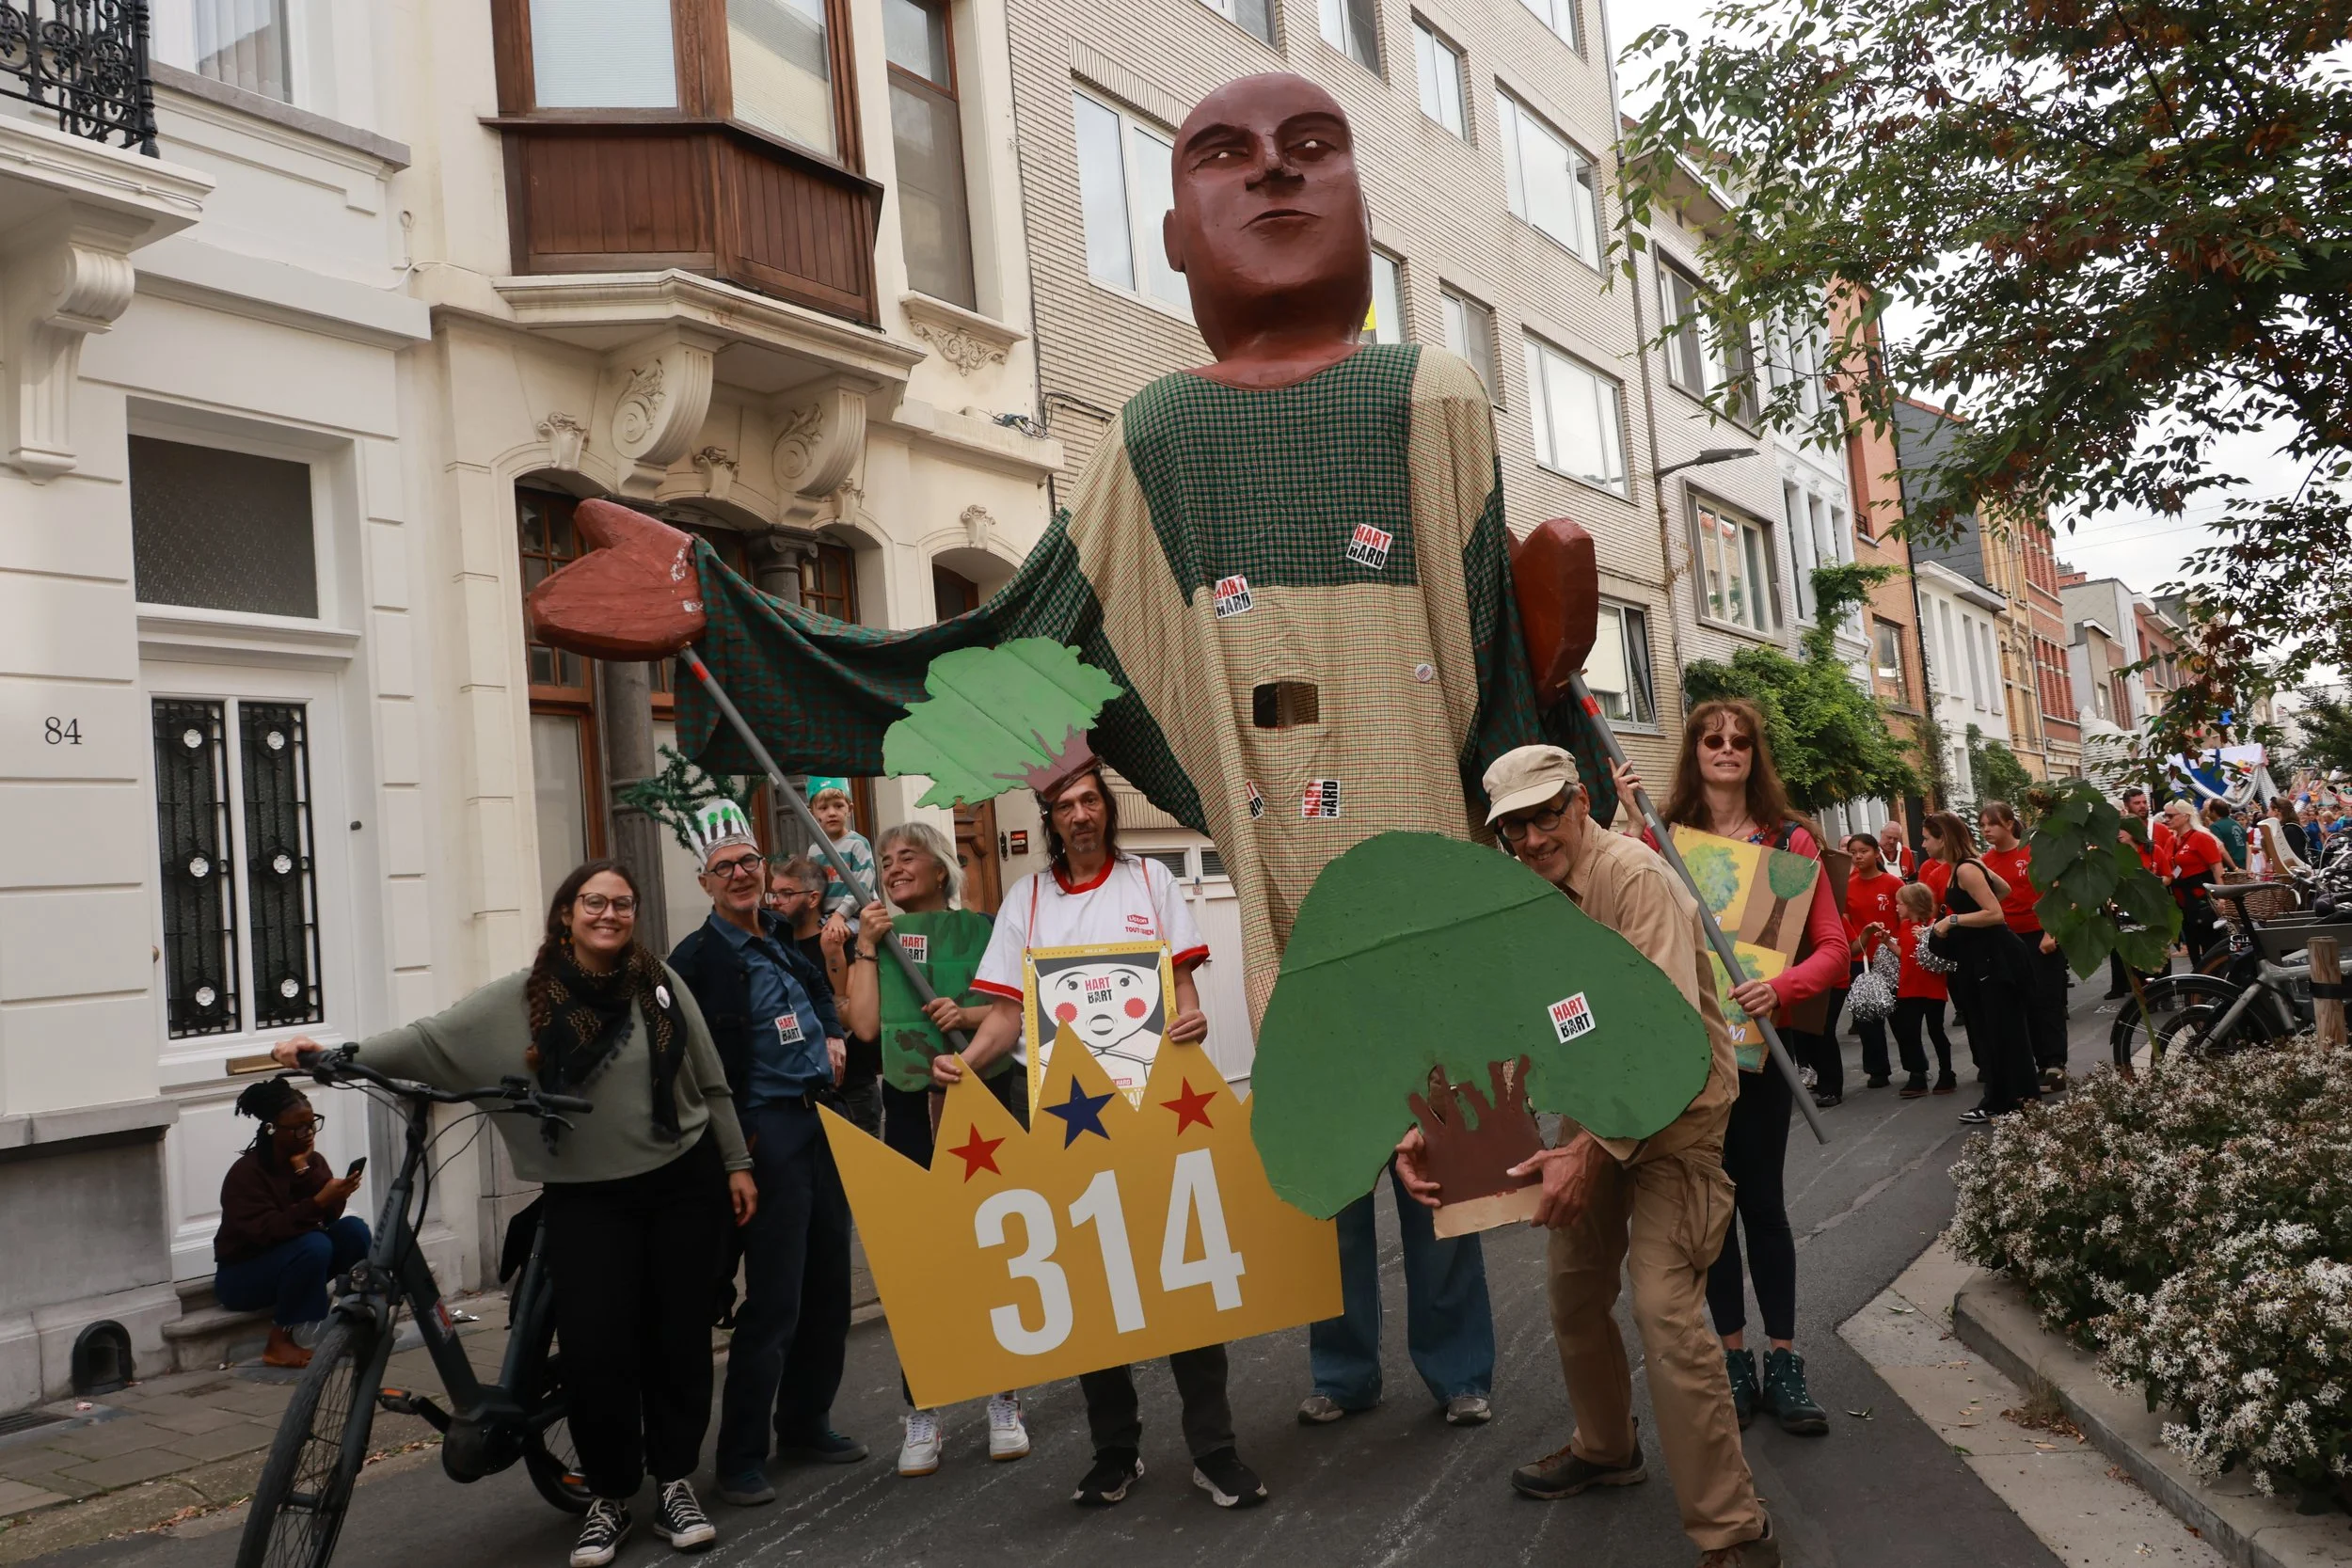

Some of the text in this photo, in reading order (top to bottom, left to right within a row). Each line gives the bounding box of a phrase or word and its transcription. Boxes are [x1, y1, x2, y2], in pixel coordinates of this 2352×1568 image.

[1354, 524, 1391, 551] HART
[1348, 544, 1386, 567] HARD
[1216, 592, 1251, 617] HARD
[45, 716, 83, 745] 84
[1322, 781, 1338, 817] HARD
[901, 936, 925, 948] HART
[1085, 976, 1110, 991] HART
[1552, 996, 1585, 1022] HART
[777, 1016, 797, 1030] HART
[974, 1147, 1247, 1356] 314
